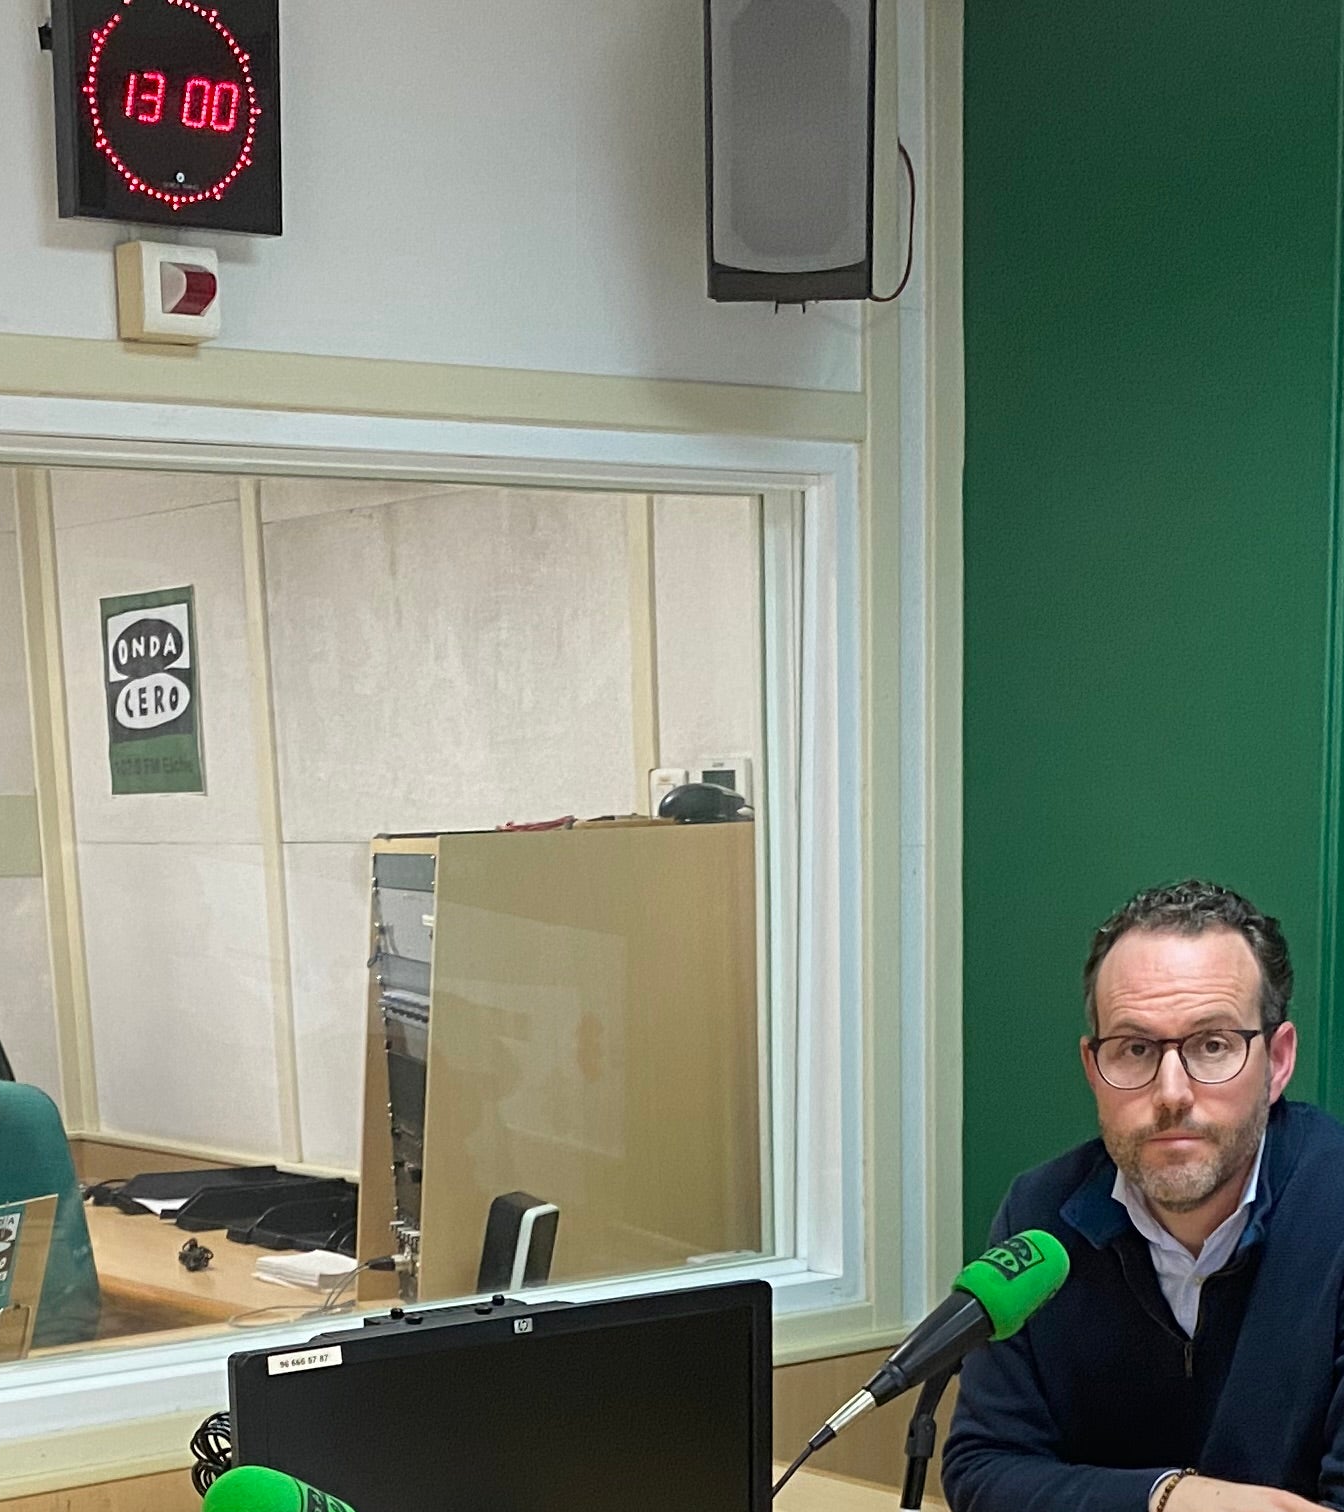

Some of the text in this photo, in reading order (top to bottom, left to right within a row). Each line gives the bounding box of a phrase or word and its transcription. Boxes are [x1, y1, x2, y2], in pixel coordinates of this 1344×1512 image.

[124, 71, 239, 132] 13 00
[118, 632, 177, 665] ONDA
[124, 685, 179, 718] CERO
